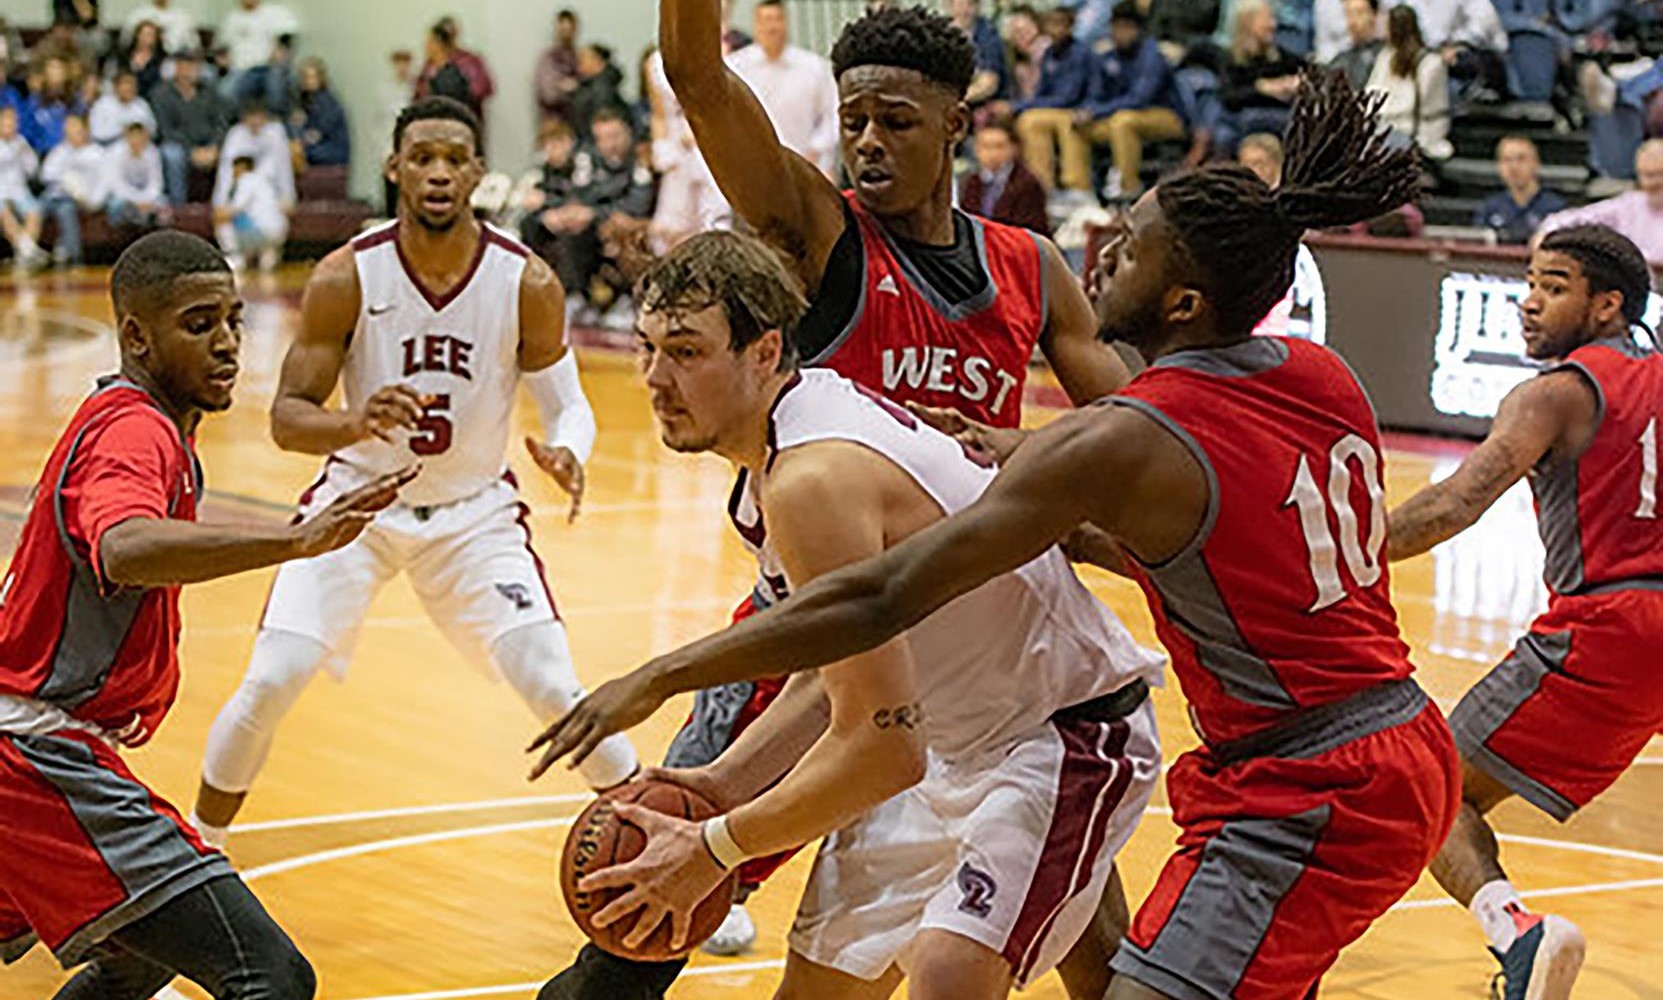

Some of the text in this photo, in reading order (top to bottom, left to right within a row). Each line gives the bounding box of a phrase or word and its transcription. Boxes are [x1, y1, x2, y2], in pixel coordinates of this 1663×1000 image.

[401, 335, 474, 381] LEE
[882, 345, 1018, 415] WEST
[409, 394, 453, 456] 5
[1283, 433, 1386, 614] 10
